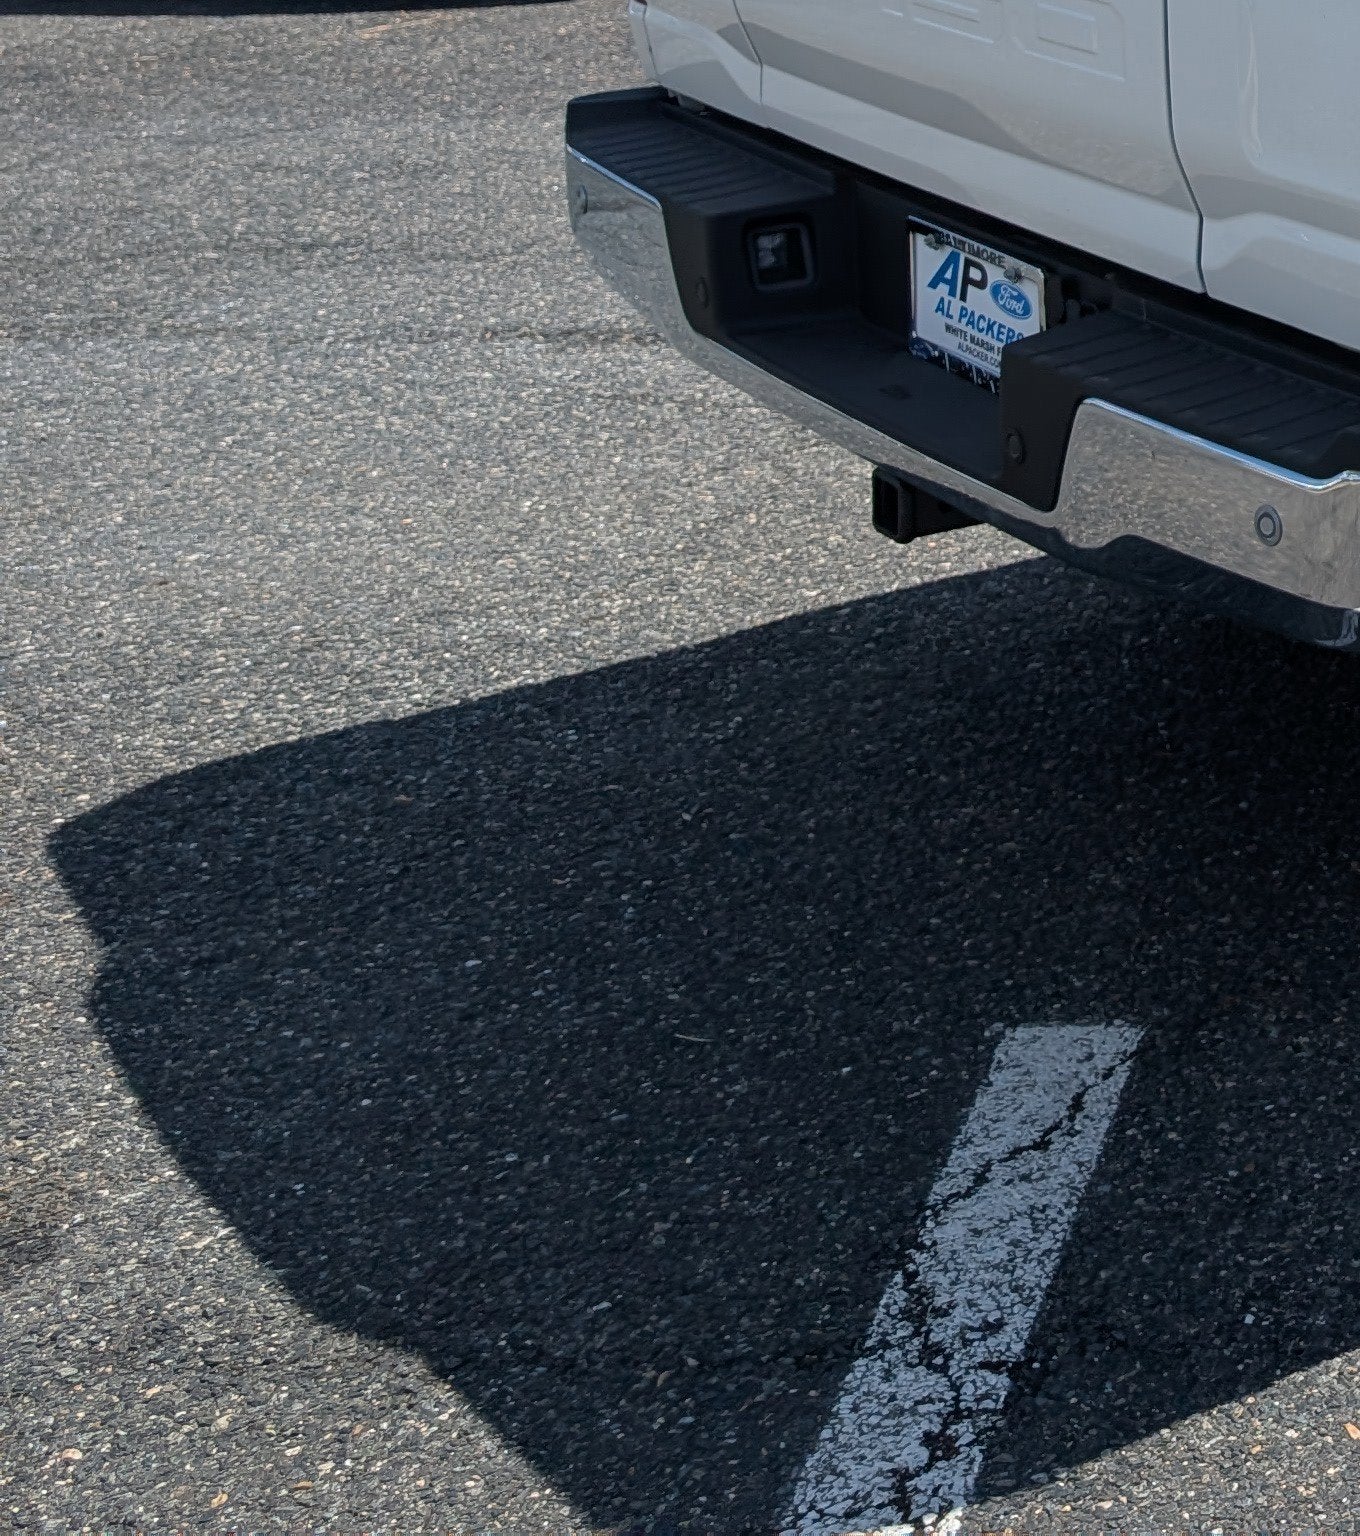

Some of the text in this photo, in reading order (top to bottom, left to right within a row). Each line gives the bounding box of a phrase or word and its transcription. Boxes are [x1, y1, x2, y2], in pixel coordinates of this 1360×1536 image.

[927, 249, 1025, 314] AP Ford
[935, 297, 954, 320] AL
